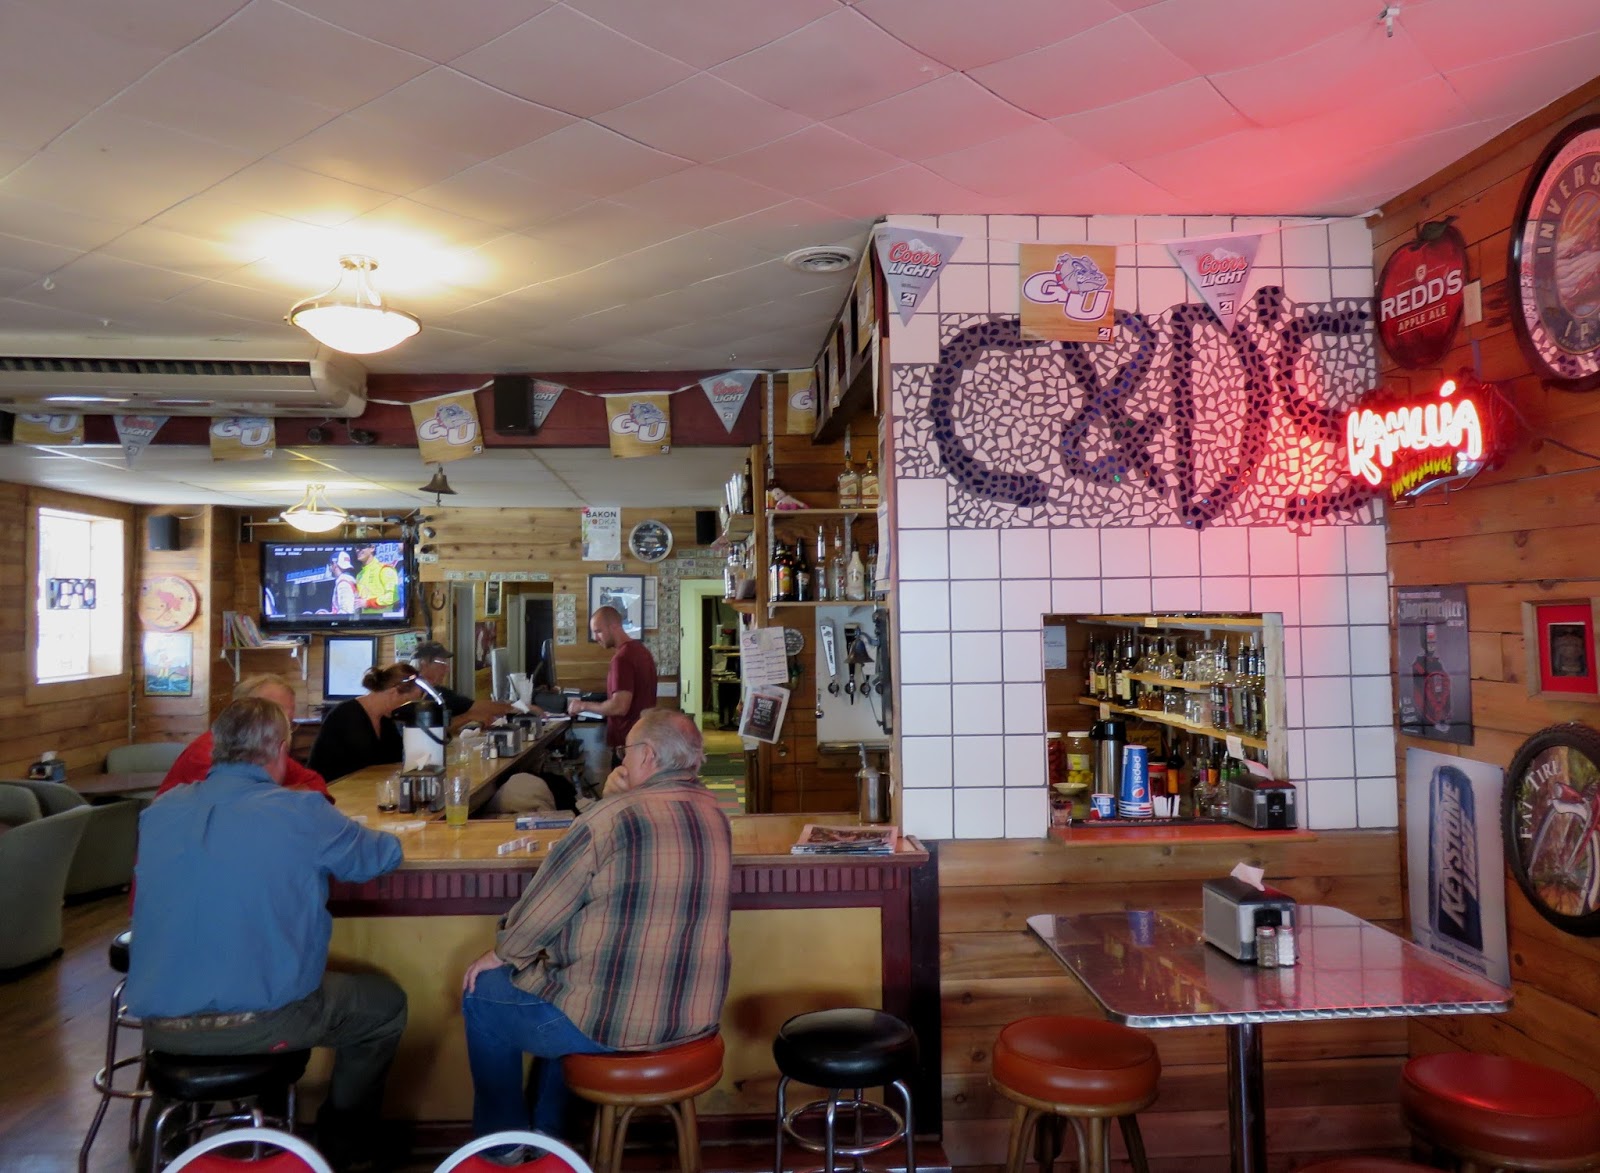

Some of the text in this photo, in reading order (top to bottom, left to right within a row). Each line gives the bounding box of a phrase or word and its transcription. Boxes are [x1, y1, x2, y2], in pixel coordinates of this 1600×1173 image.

[889, 241, 942, 267] Coors
[1197, 253, 1248, 276] Coors
[888, 262, 938, 278] LIGHT
[1201, 270, 1246, 288] LIGHT
[901, 292, 917, 304] 21
[1023, 271, 1112, 321] GU
[1220, 301, 1233, 312] 21
[1381, 270, 1463, 323] REDD'S
[1398, 305, 1446, 332] APPLE ALE
[1098, 328, 1111, 338] 21
[534, 393, 556, 401] GHT
[714, 394, 745, 403] LIGHT
[122, 428, 153, 437] LIGHT
[212, 420, 272, 446] GU
[418, 419, 477, 446] GU
[611, 413, 669, 443] GU
[1132, 755, 1143, 784] pepsi
[1441, 780, 1466, 930] KEYSTONE
